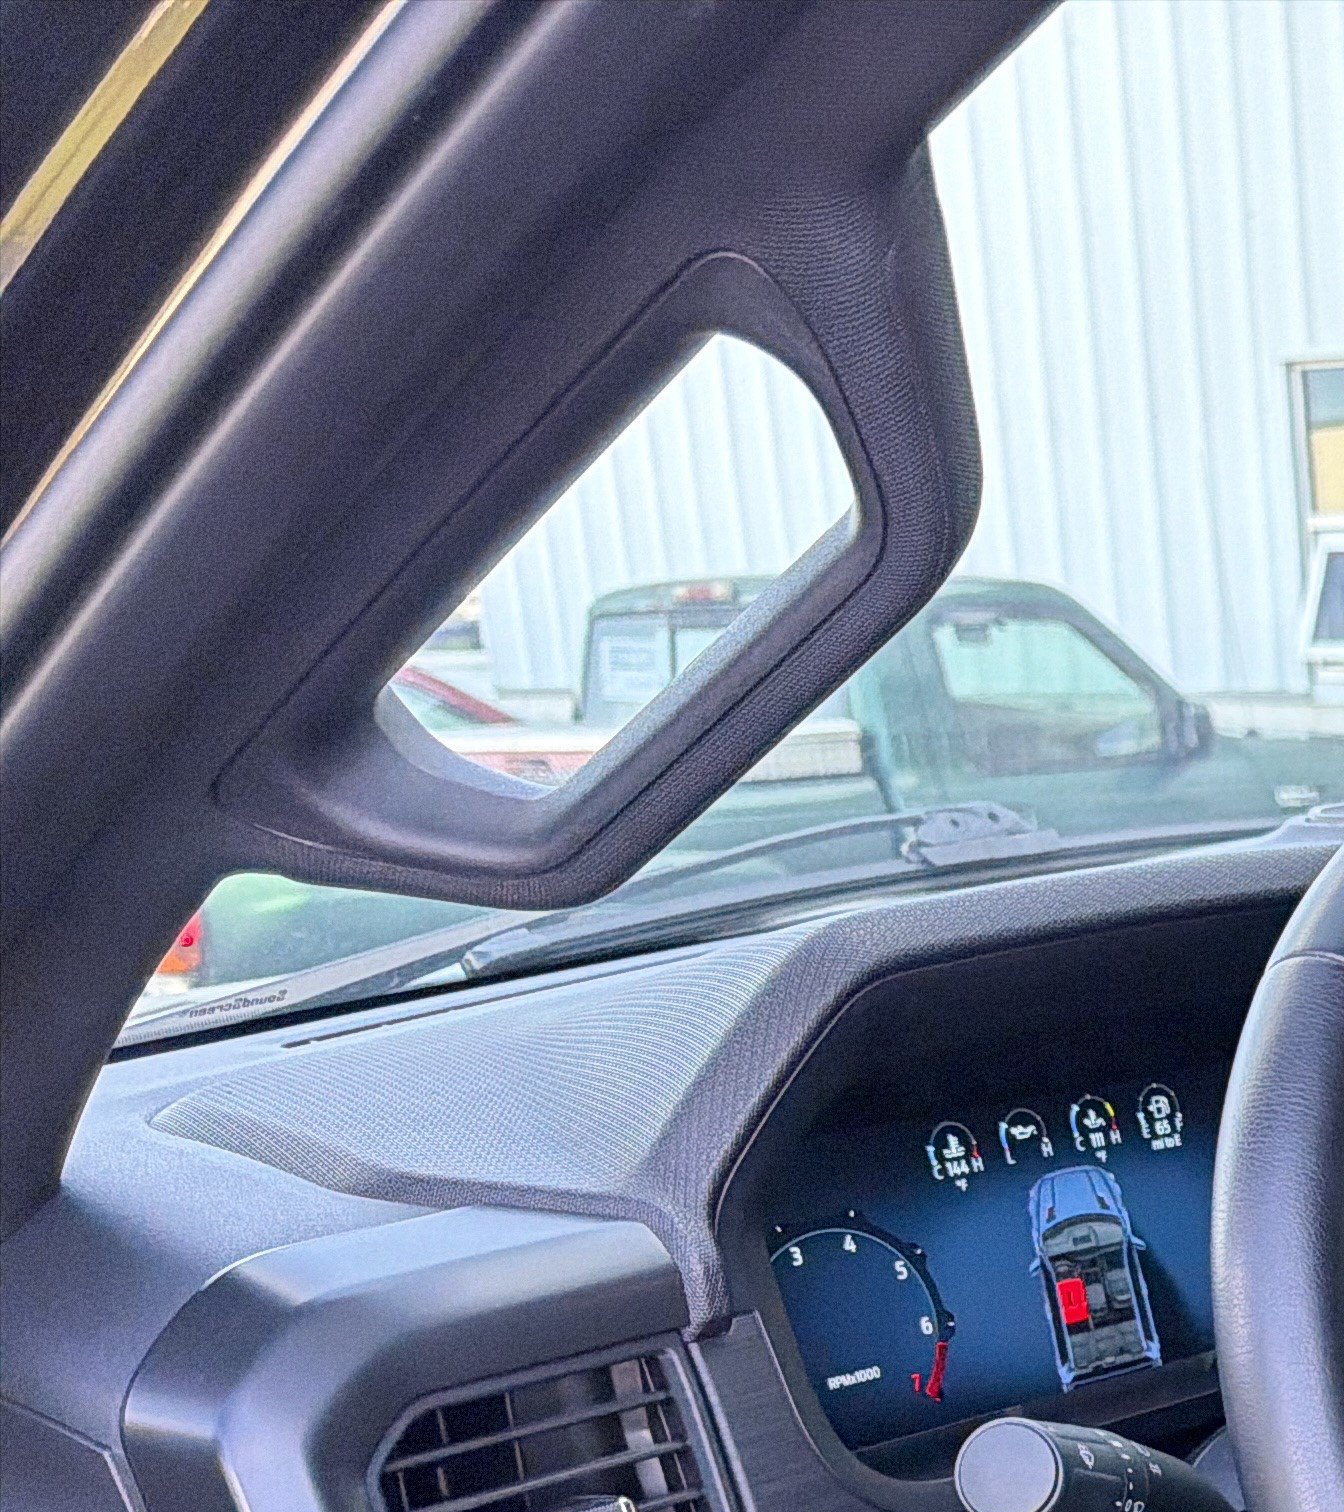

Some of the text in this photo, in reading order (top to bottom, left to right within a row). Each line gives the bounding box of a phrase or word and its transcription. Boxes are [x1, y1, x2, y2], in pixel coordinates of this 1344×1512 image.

[1154, 1118, 1171, 1136] 65
[1040, 1140, 1054, 1158] H
[1075, 1129, 1121, 1152] C 111 H
[932, 1156, 985, 1180] C 144 H
[842, 1234, 857, 1253] 4
[788, 1246, 804, 1267] 3
[894, 1260, 908, 1280] 5
[919, 1316, 933, 1335] 6
[826, 1365, 881, 1391] RPMx1000
[911, 1373, 922, 1392] 7
